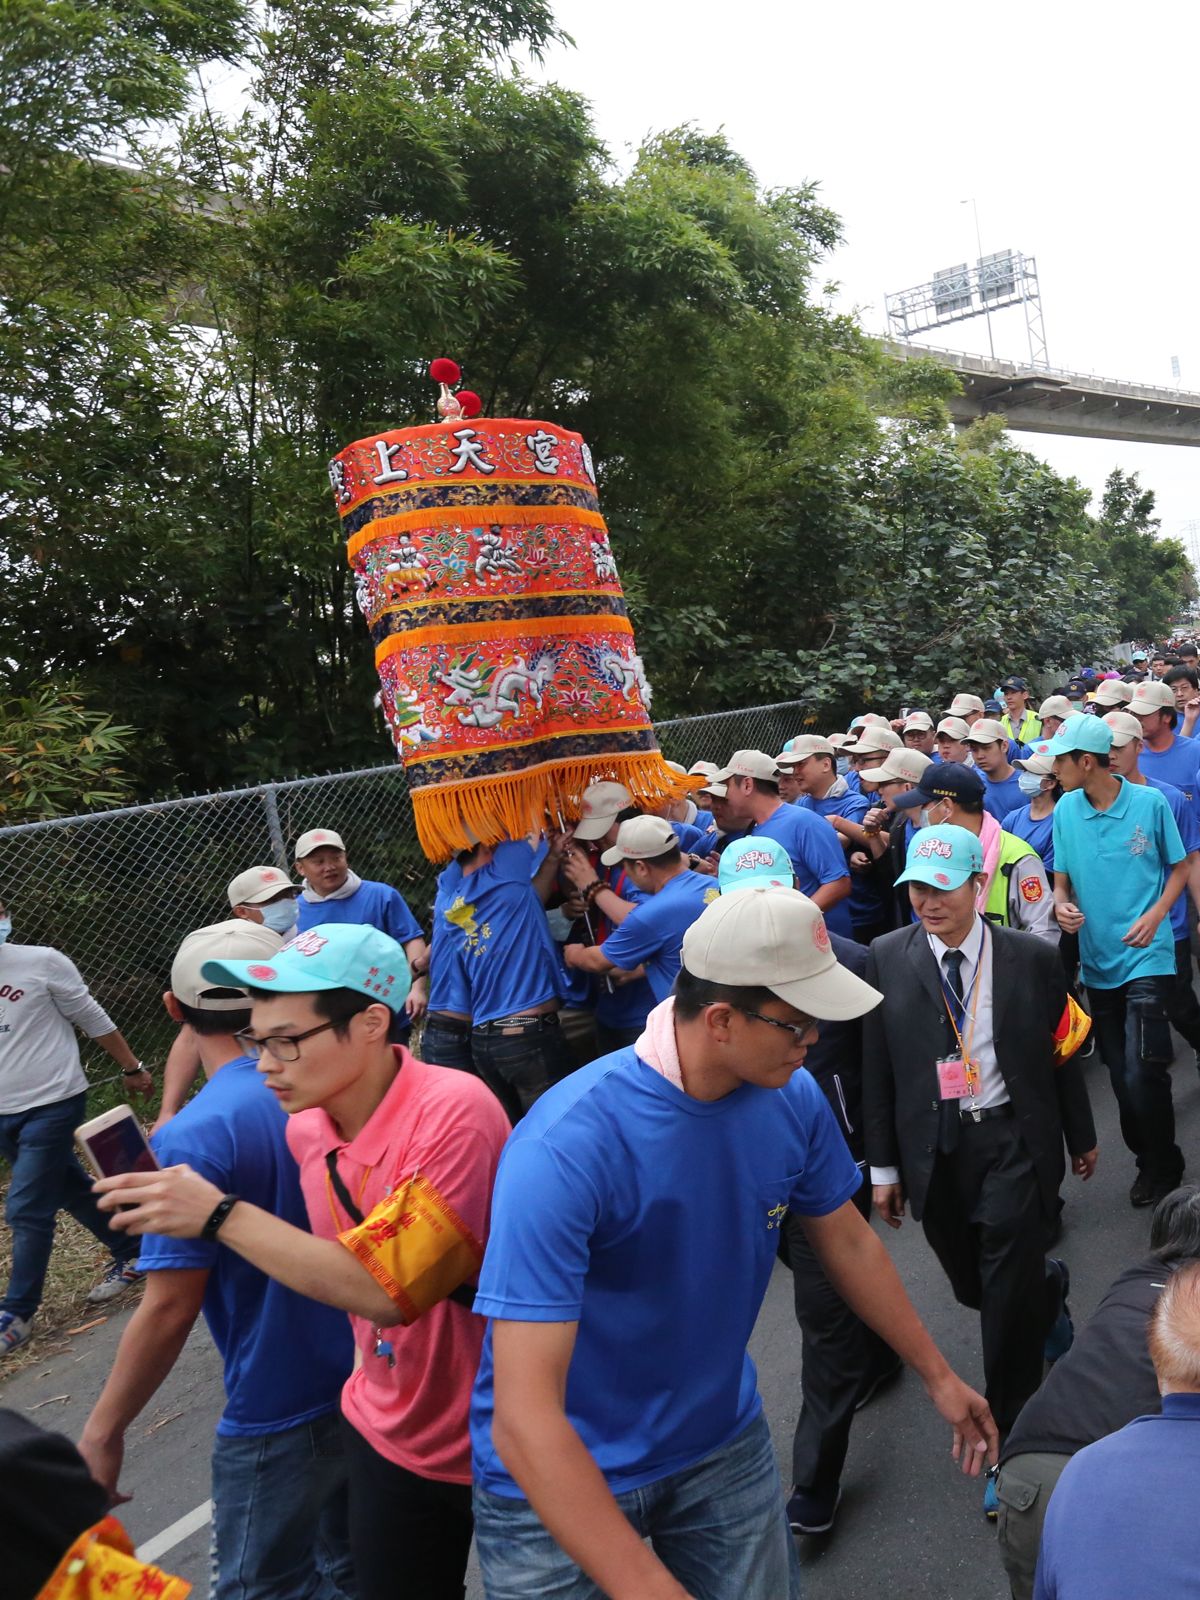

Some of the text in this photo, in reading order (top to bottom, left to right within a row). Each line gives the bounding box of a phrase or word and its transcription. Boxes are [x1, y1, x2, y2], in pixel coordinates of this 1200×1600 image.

[913, 837, 953, 859] 大甲媽
[736, 850, 774, 873] 大甲媽
